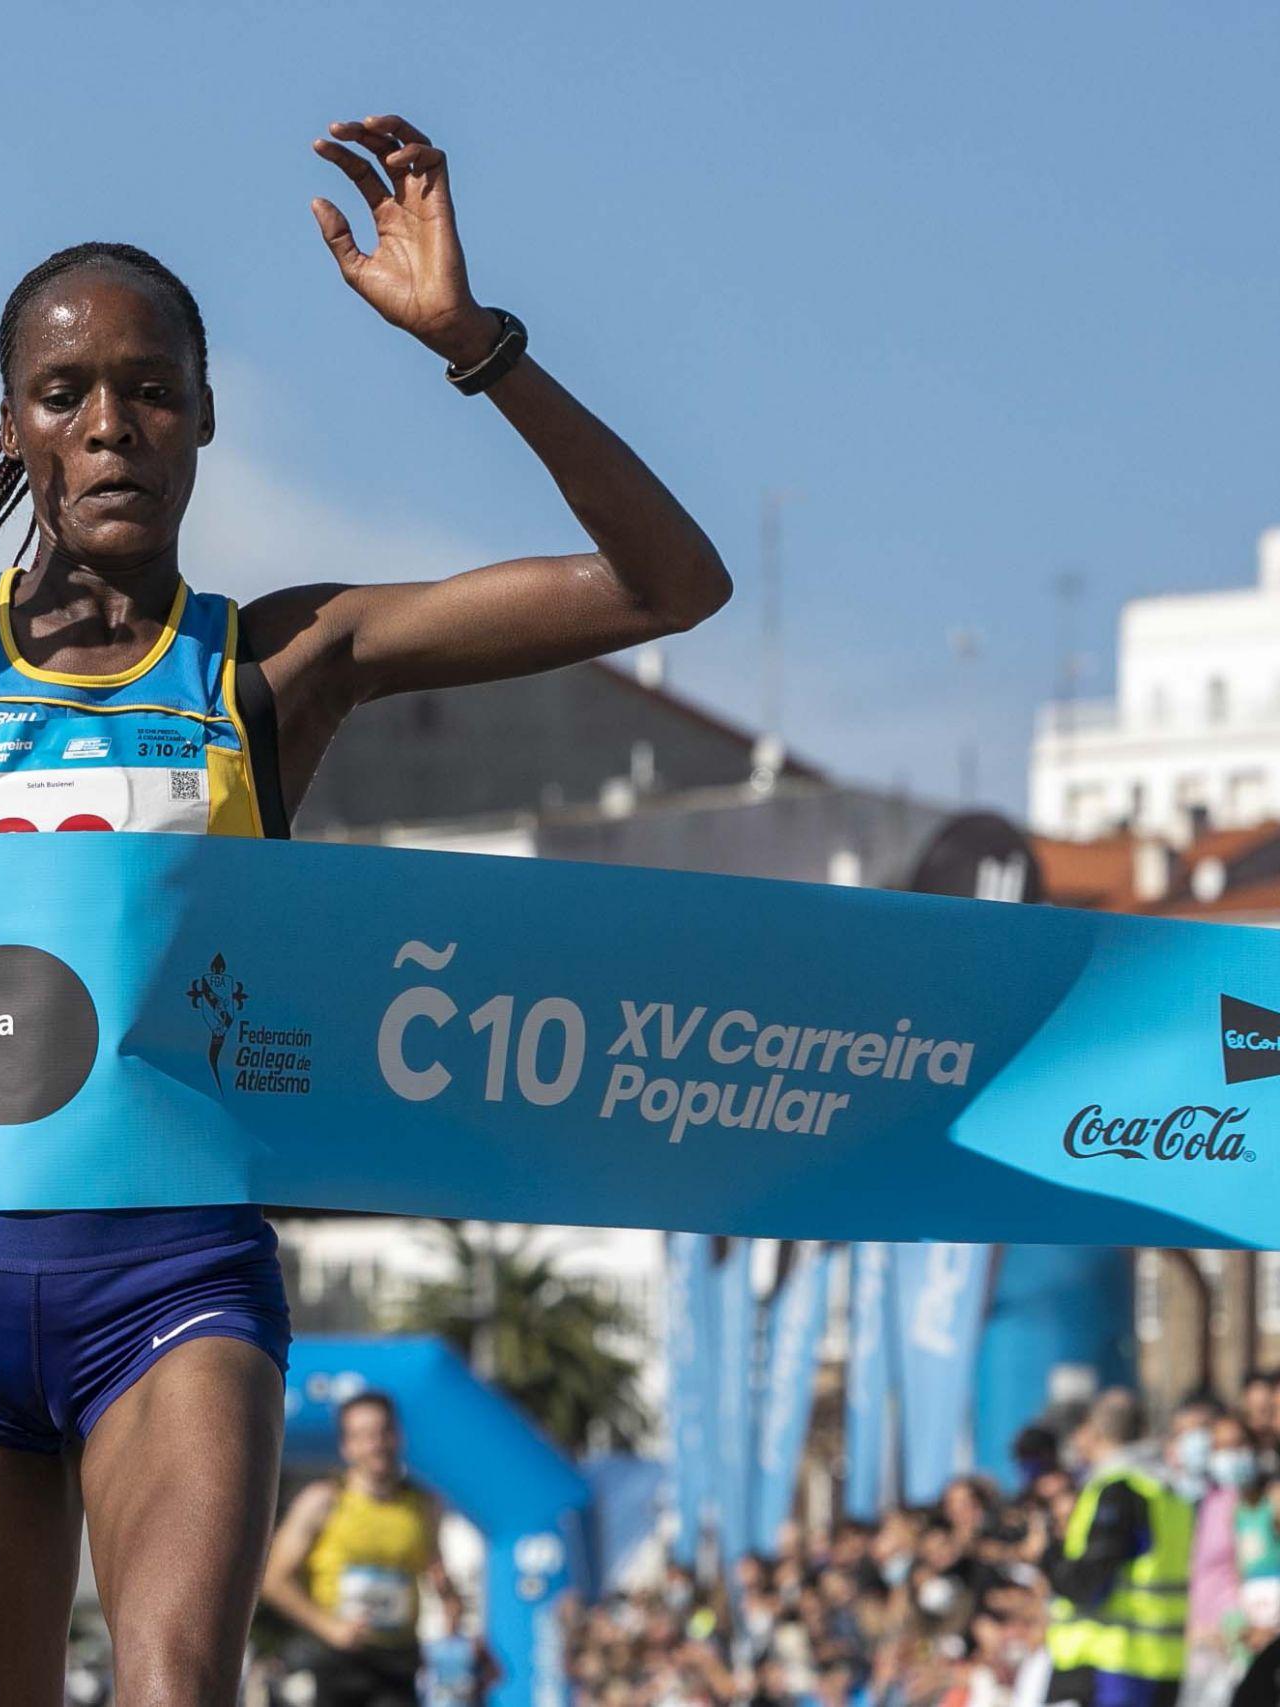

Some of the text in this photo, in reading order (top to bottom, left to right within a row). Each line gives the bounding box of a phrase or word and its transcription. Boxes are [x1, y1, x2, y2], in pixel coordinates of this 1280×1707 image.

[27, 781, 45, 789] Selah
[238, 1020, 312, 1048] Federación
[606, 1000, 975, 1086] XV Carreira
[1246, 1032, 1280, 1051] Cor
[235, 1047, 312, 1075] Galega de
[235, 1070, 310, 1094] Atletismo
[599, 1064, 850, 1143] Popular
[1063, 1104, 1251, 1161] Coca-Cola
